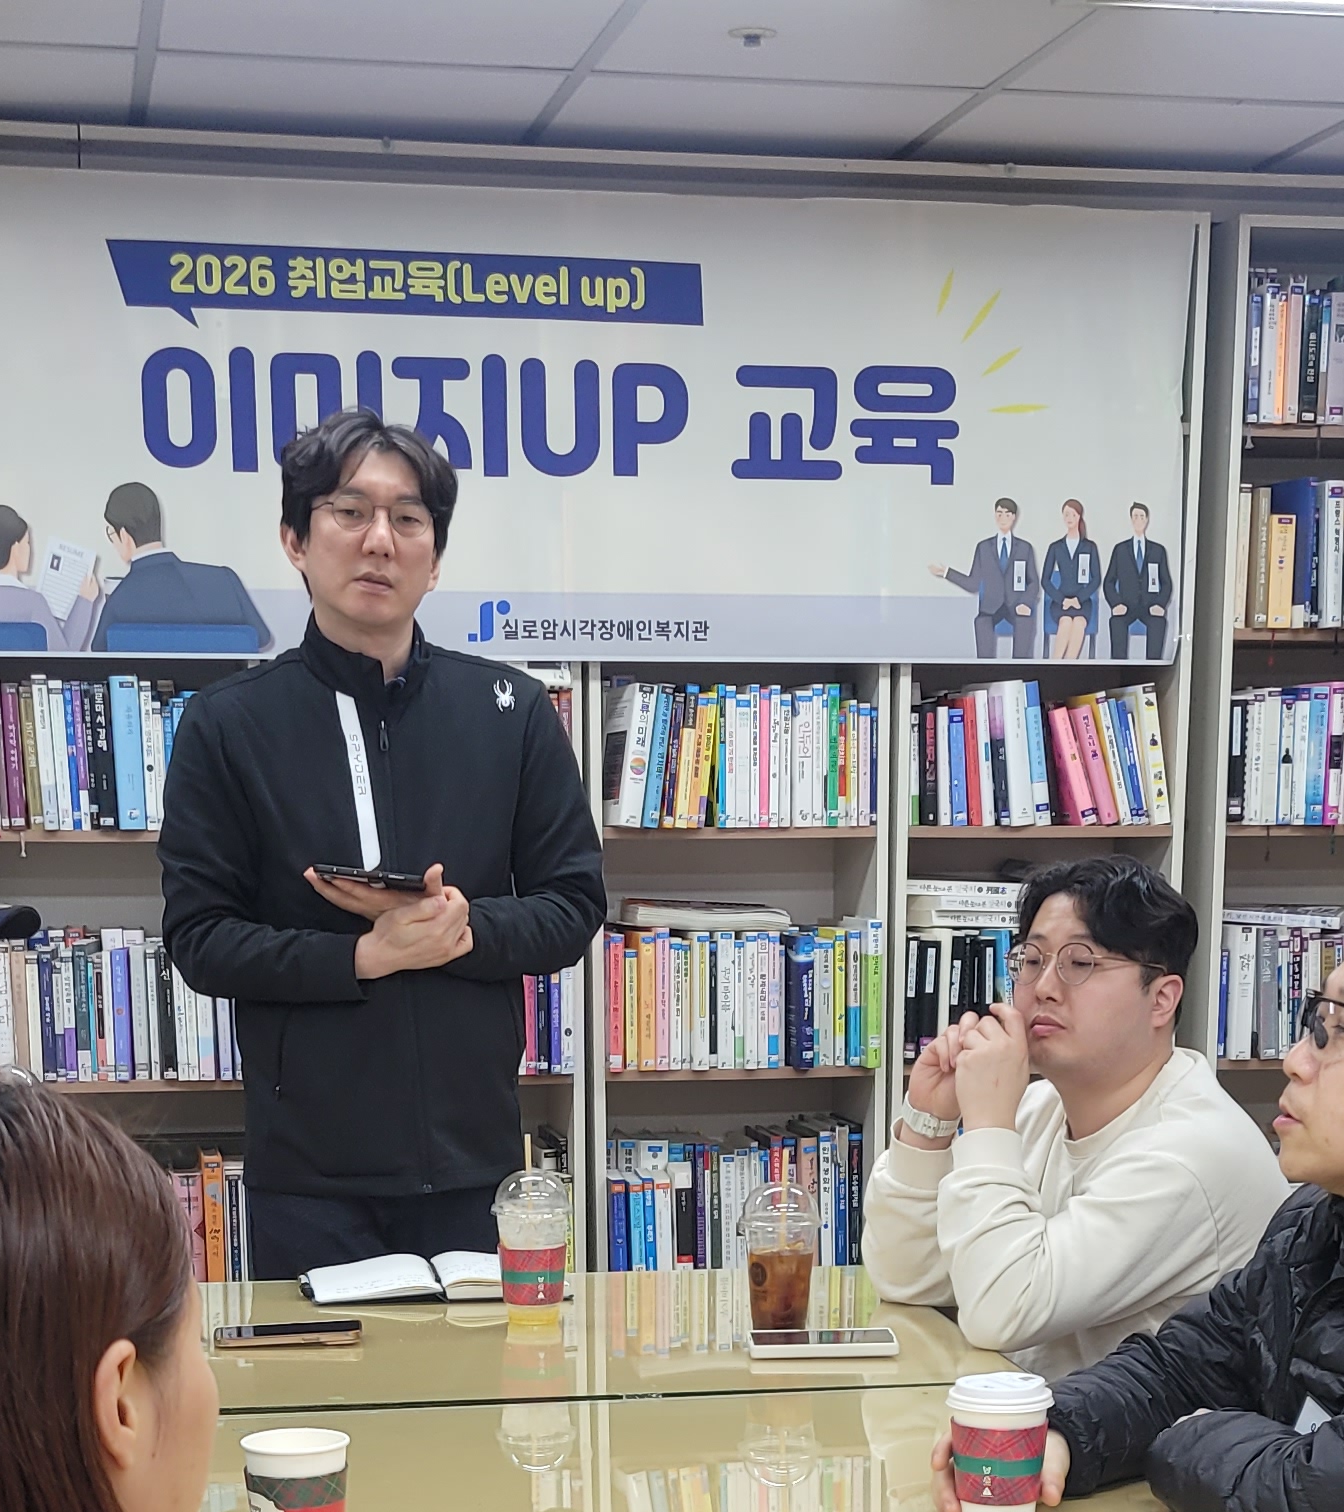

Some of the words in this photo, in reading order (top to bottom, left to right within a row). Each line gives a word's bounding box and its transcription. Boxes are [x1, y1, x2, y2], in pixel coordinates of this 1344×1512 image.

[169, 252, 276, 298] 2026
[287, 256, 570, 306] 취업교육(Level
[581, 266, 646, 314] up)
[140, 346, 690, 478] 이미지UP
[731, 365, 961, 487] 교육
[1333, 500, 1342, 526] 프랑스
[501, 617, 712, 644] 실로암시각장애인복지관
[798, 721, 812, 759] 인듀어
[349, 734, 367, 796] SPYDER
[720, 986, 731, 1013] 바이블
